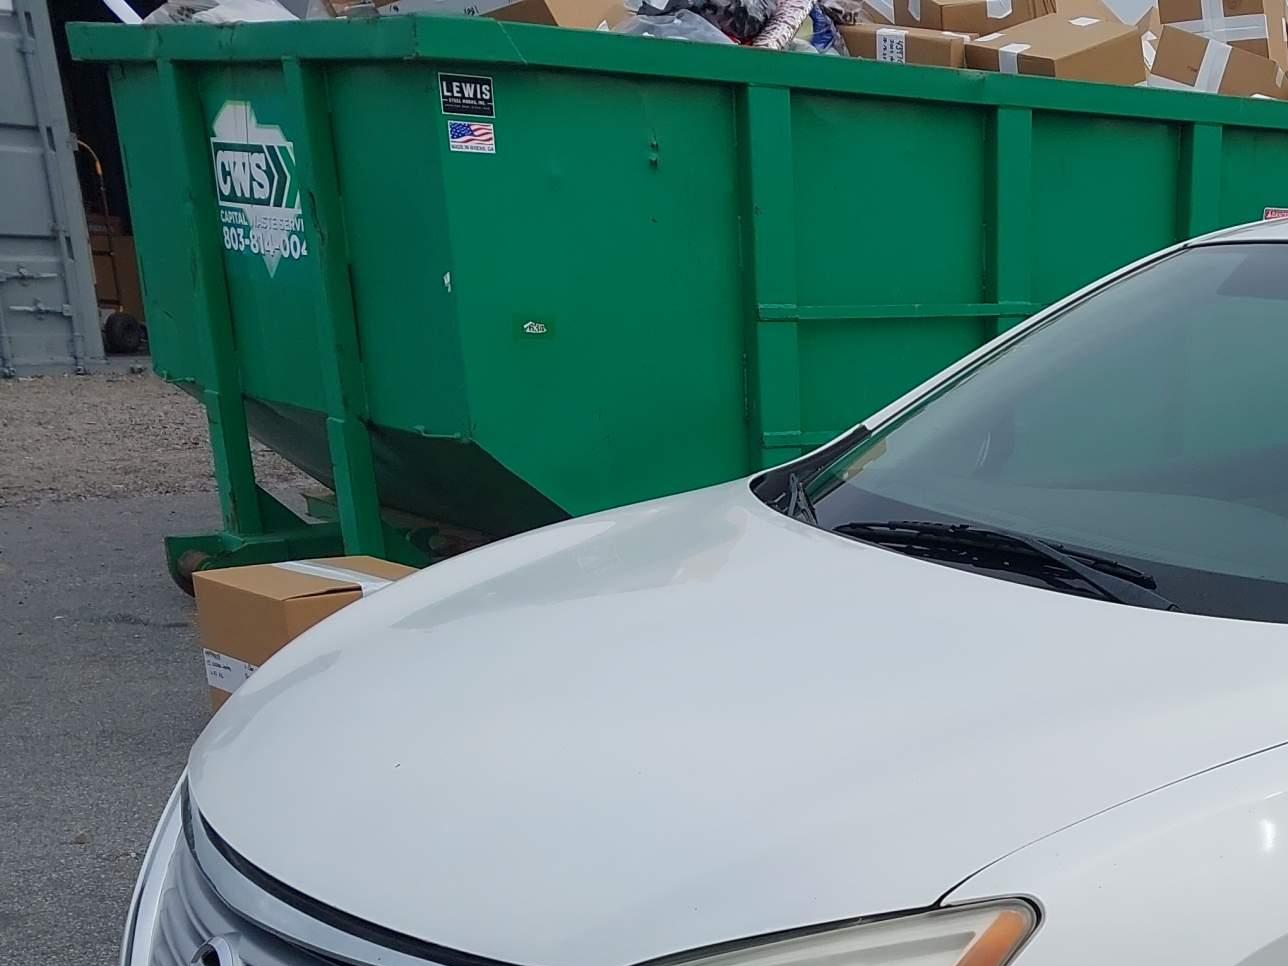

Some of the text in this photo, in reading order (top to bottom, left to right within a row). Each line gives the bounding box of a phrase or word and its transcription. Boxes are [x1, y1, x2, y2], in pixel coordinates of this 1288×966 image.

[443, 81, 491, 99] LEWIS
[216, 150, 271, 199] CWS
[220, 209, 249, 226] CAPITAL
